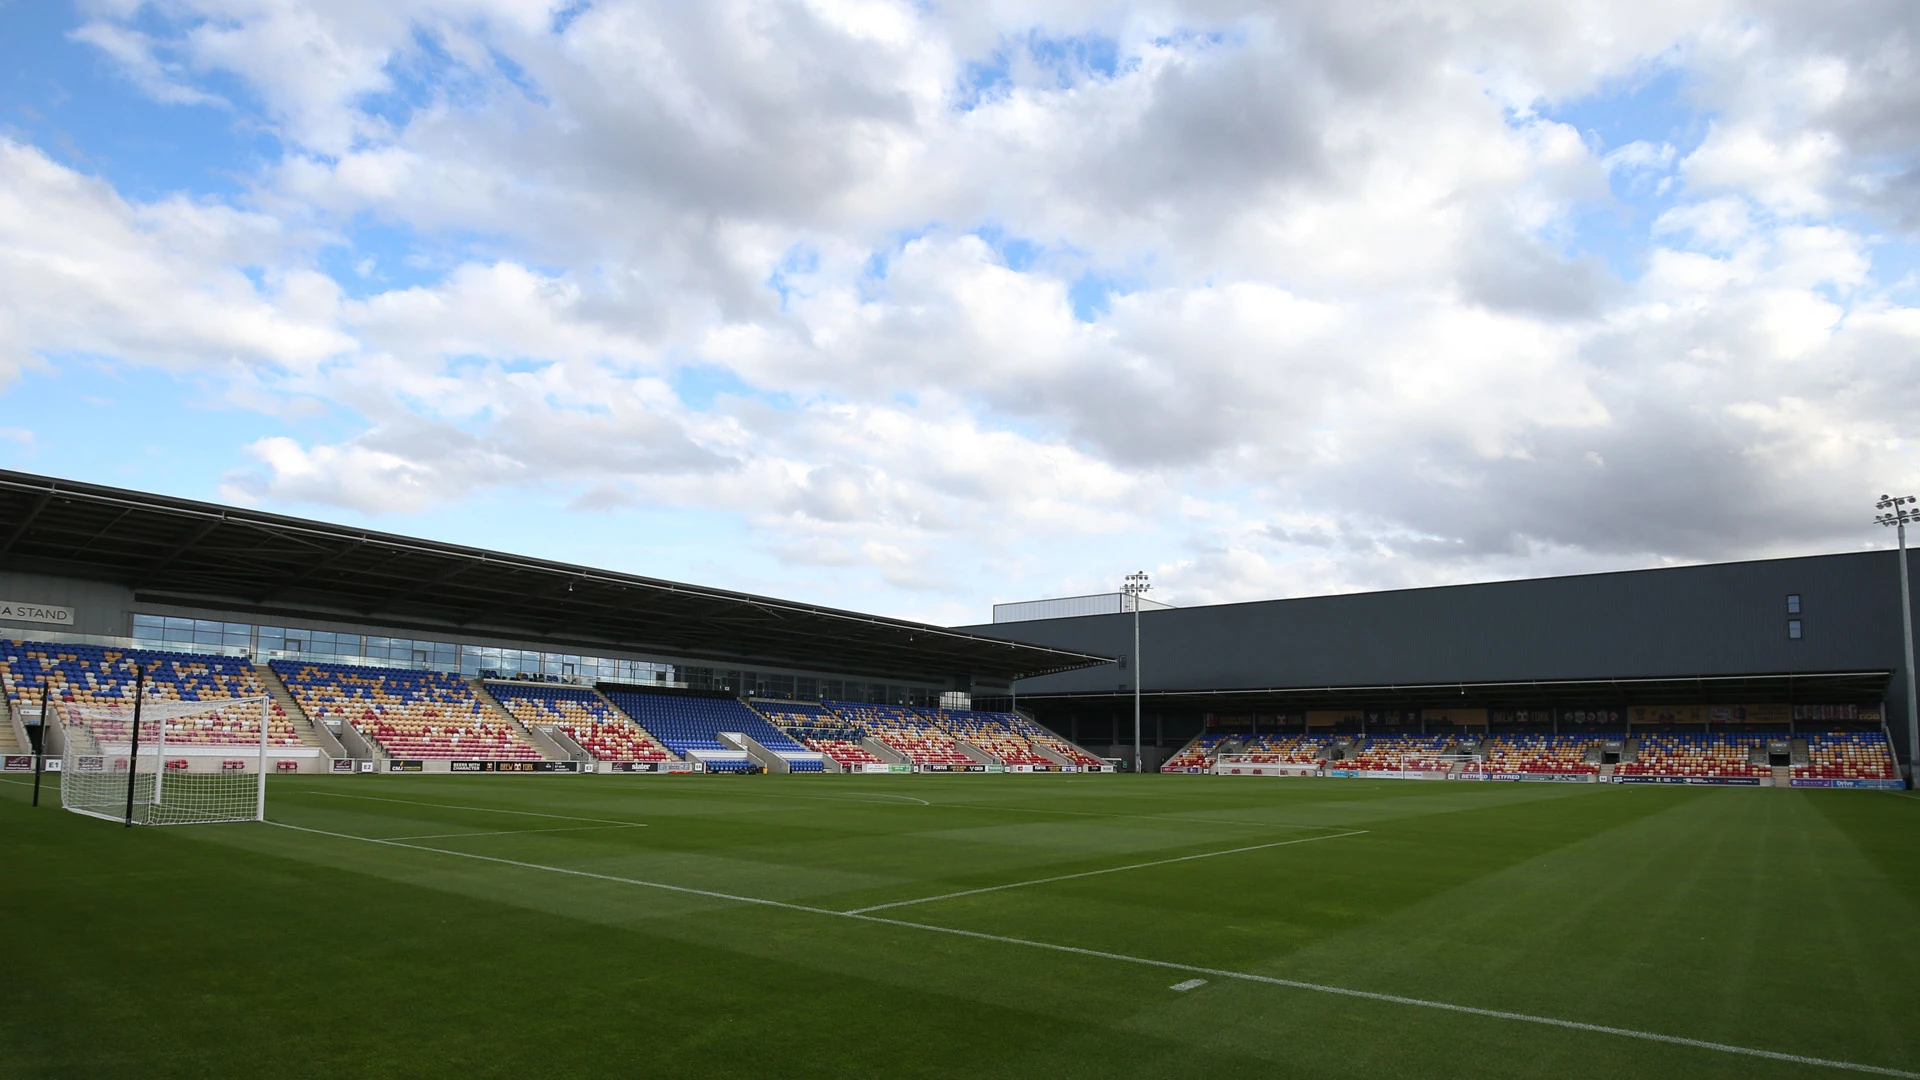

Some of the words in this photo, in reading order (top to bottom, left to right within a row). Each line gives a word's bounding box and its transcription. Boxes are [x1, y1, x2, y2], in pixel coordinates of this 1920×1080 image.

[0, 606, 12, 616] A
[17, 606, 68, 620] STAND
[500, 763, 513, 771] BREW
[522, 763, 533, 771] YORK
